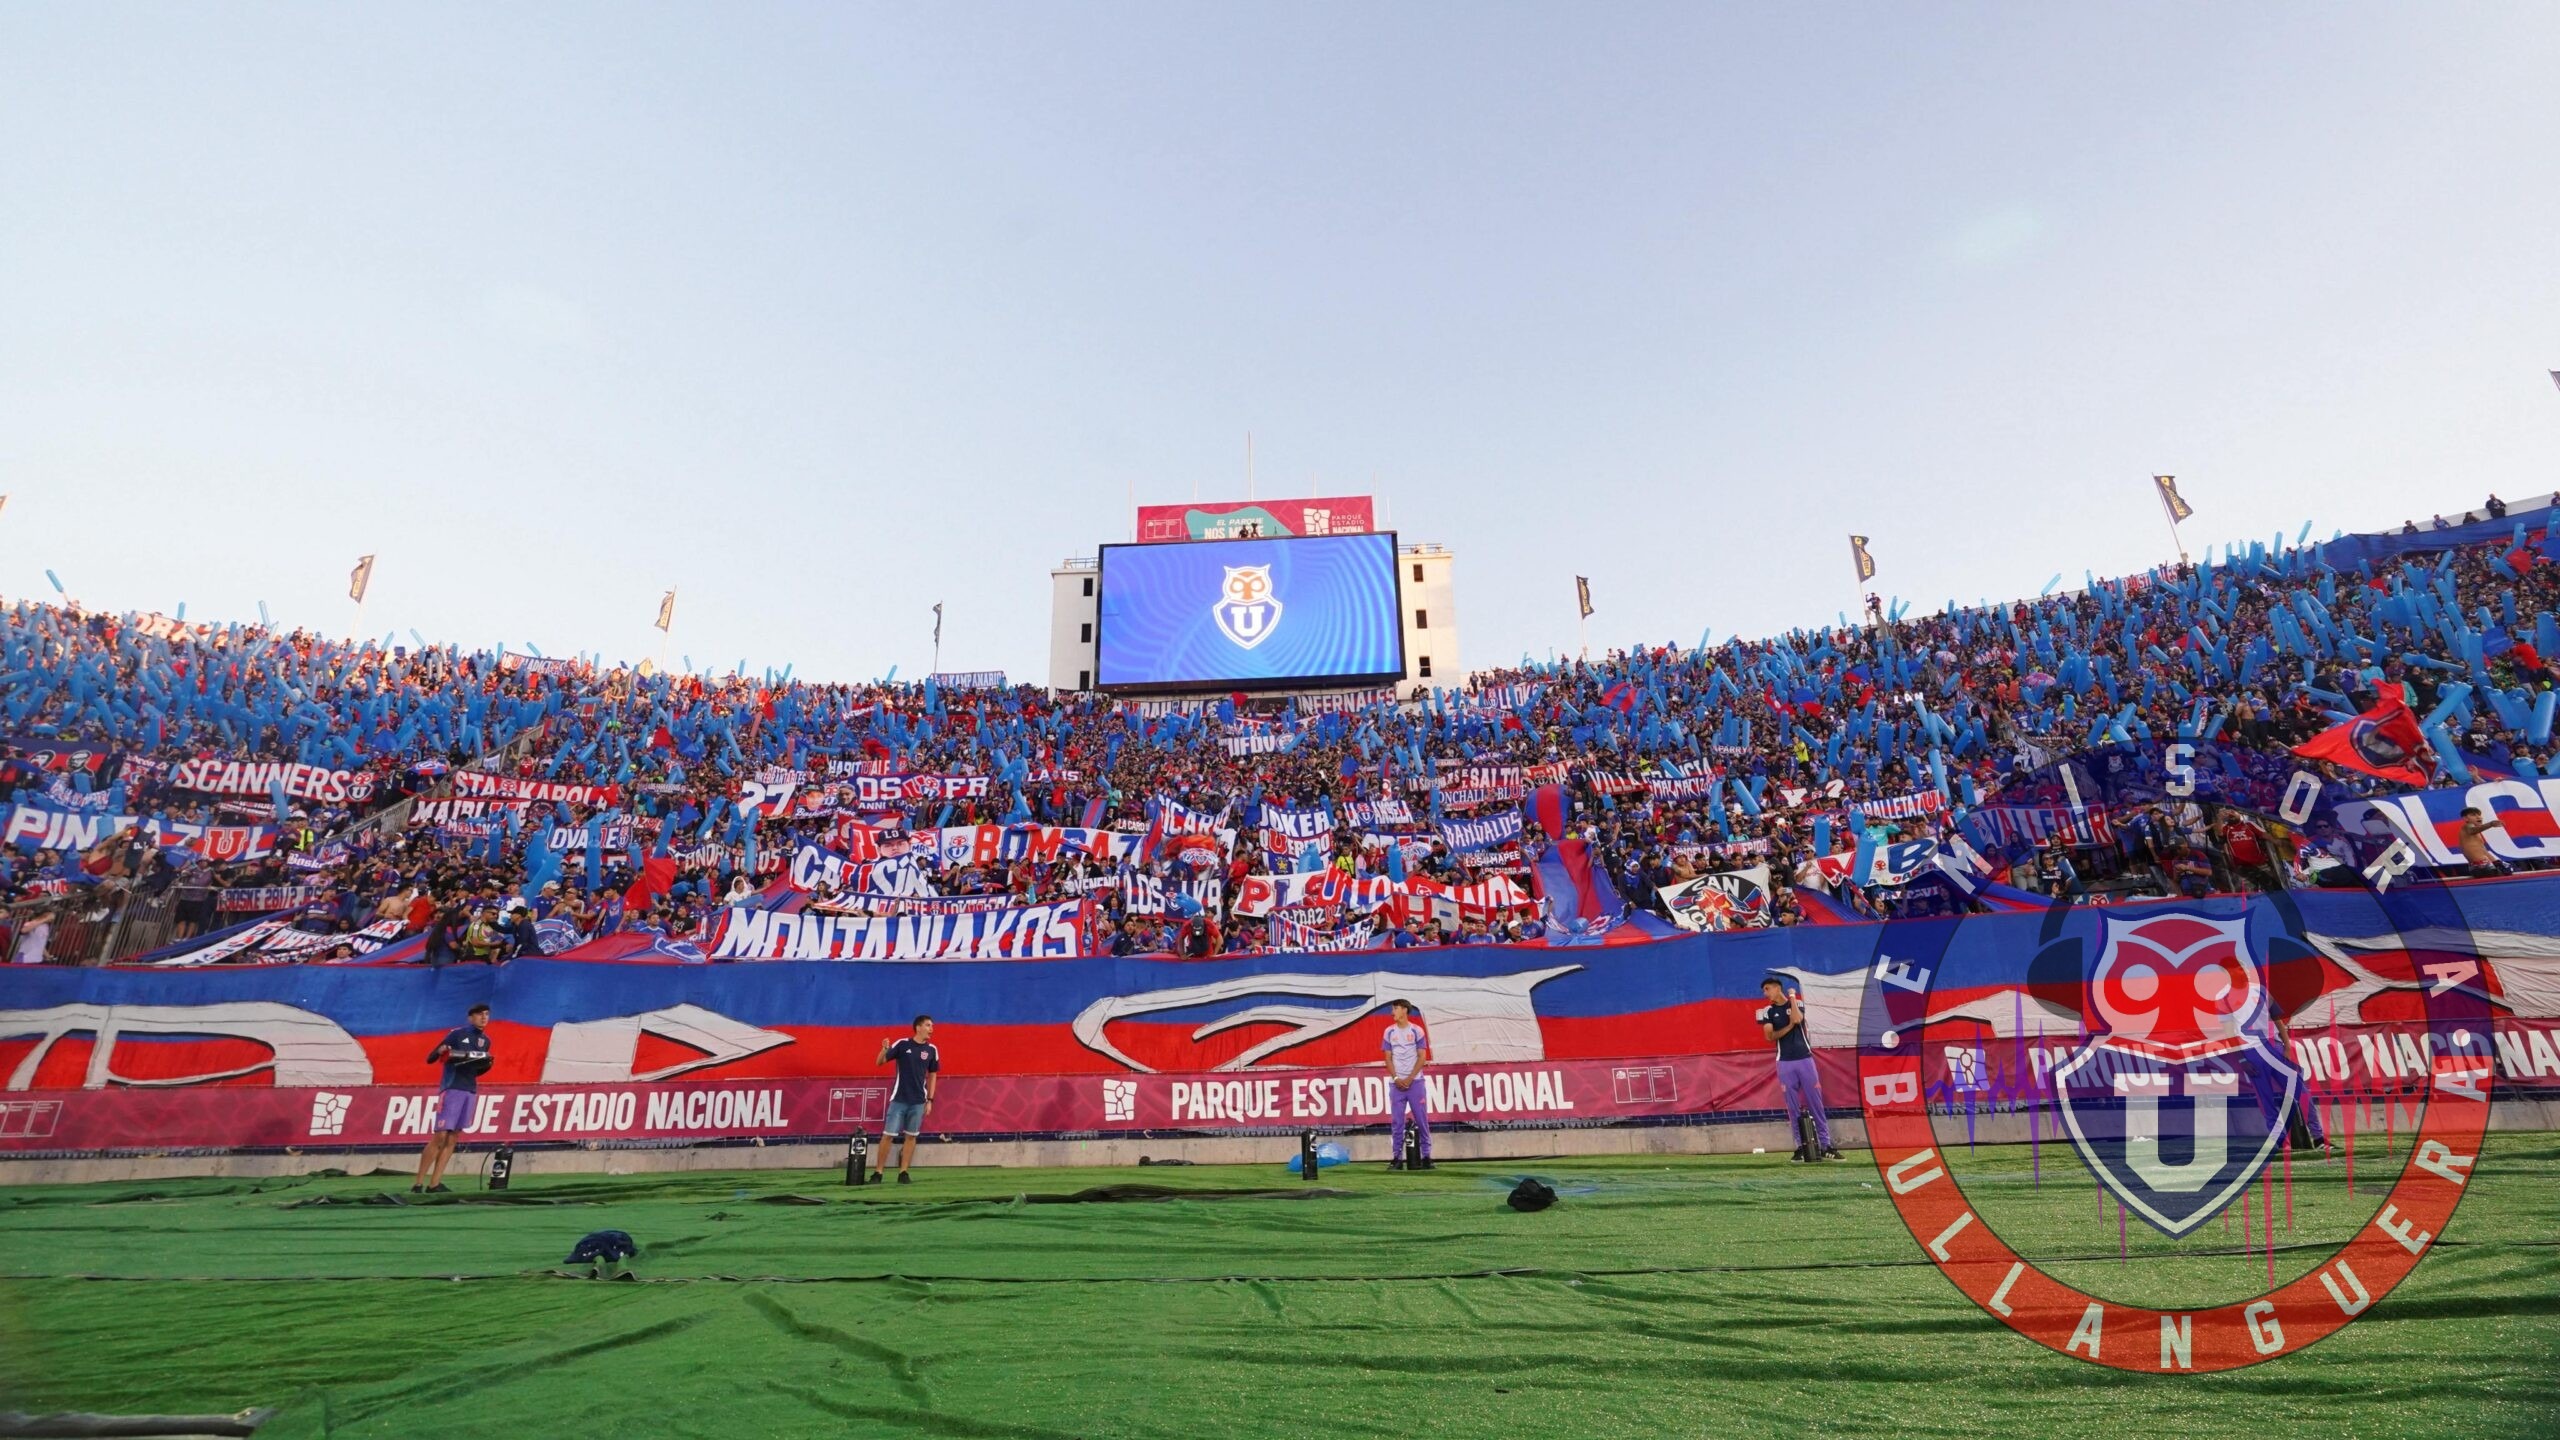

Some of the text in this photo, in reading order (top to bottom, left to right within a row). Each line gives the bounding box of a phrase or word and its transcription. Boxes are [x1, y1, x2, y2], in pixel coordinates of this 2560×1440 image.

[1204, 528, 1225, 539] NOS
[1229, 517, 1264, 526] PARQUE
[1231, 605, 1264, 637] U
[175, 758, 350, 802] SCANNERS
[454, 771, 608, 811] STA KAROL
[857, 777, 902, 800] OS
[1438, 784, 1527, 804] ONCHALI BLUE
[737, 781, 796, 819] 27
[1259, 803, 1330, 837] JOKER
[1125, 873, 1165, 915] LOS
[717, 902, 1080, 960] MONTANIAKOS
[382, 1089, 789, 1135] PARUE ESTADIO NACIONAL
[1171, 1071, 1574, 1120] PARQUE ESTADI NACIONAL
